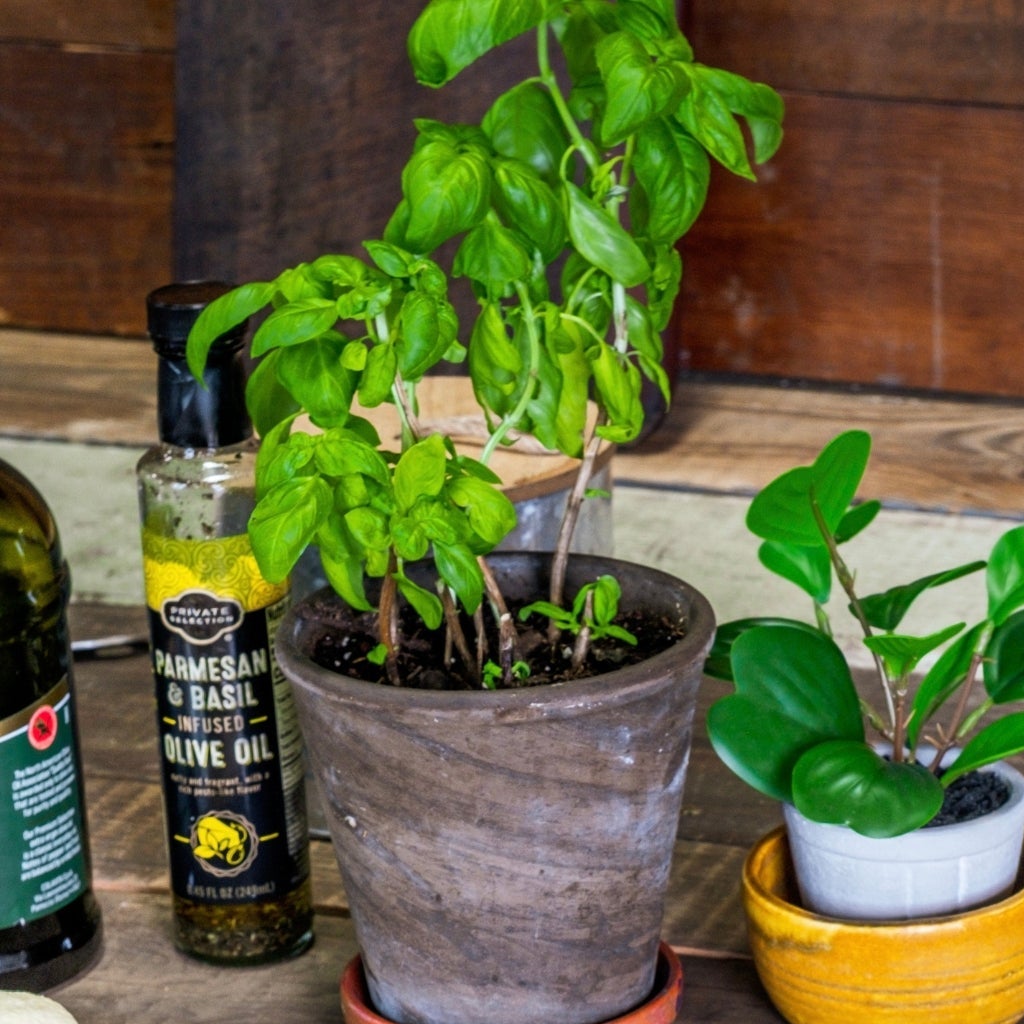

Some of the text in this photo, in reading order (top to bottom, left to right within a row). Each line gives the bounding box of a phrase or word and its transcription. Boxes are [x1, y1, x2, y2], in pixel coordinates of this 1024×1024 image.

[169, 615, 234, 625] SELECTION
[170, 606, 230, 617] PRIVATE
[155, 648, 268, 682] PARMESAN
[168, 681, 259, 711] & BASIL
[178, 715, 245, 733] INFUSED
[164, 733, 274, 768] OLIVE OIL
